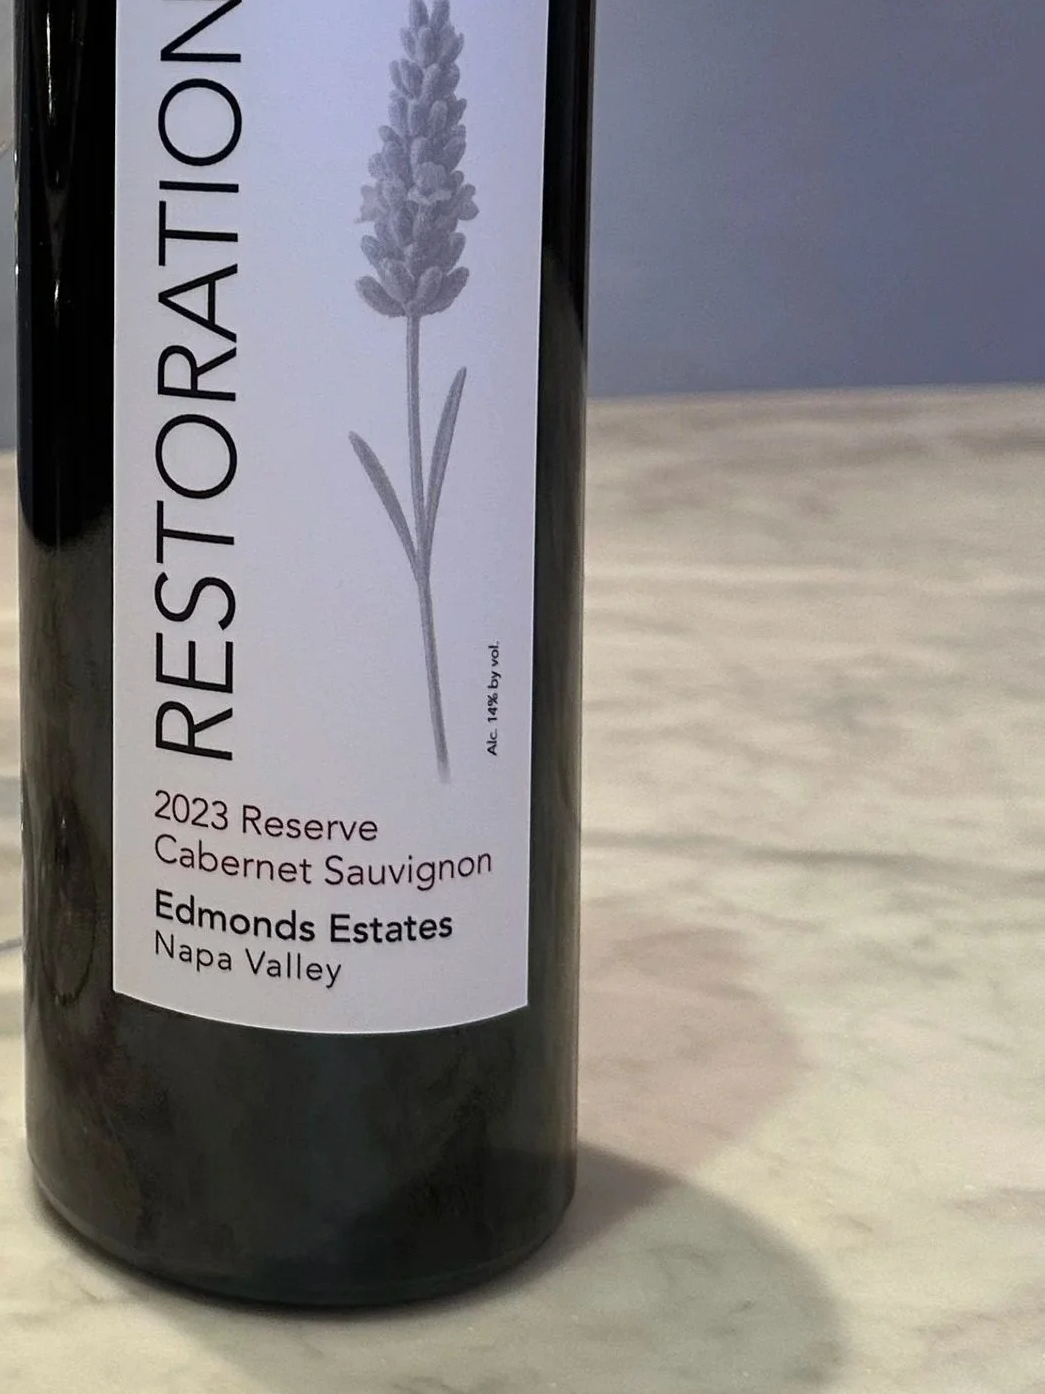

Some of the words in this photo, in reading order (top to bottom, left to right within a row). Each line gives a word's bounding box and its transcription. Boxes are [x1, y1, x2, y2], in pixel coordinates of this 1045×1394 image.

[486, 670, 502, 690] by
[486, 692, 499, 723] 14%
[154, 789, 229, 831] 2023
[241, 804, 379, 843] Reserve
[154, 833, 313, 885] Cabernet
[324, 852, 492, 892] Sauvignon
[154, 887, 317, 944] Edmonds
[329, 913, 454, 945] Estates
[154, 929, 233, 973] Napa
[244, 947, 343, 990] Valley
